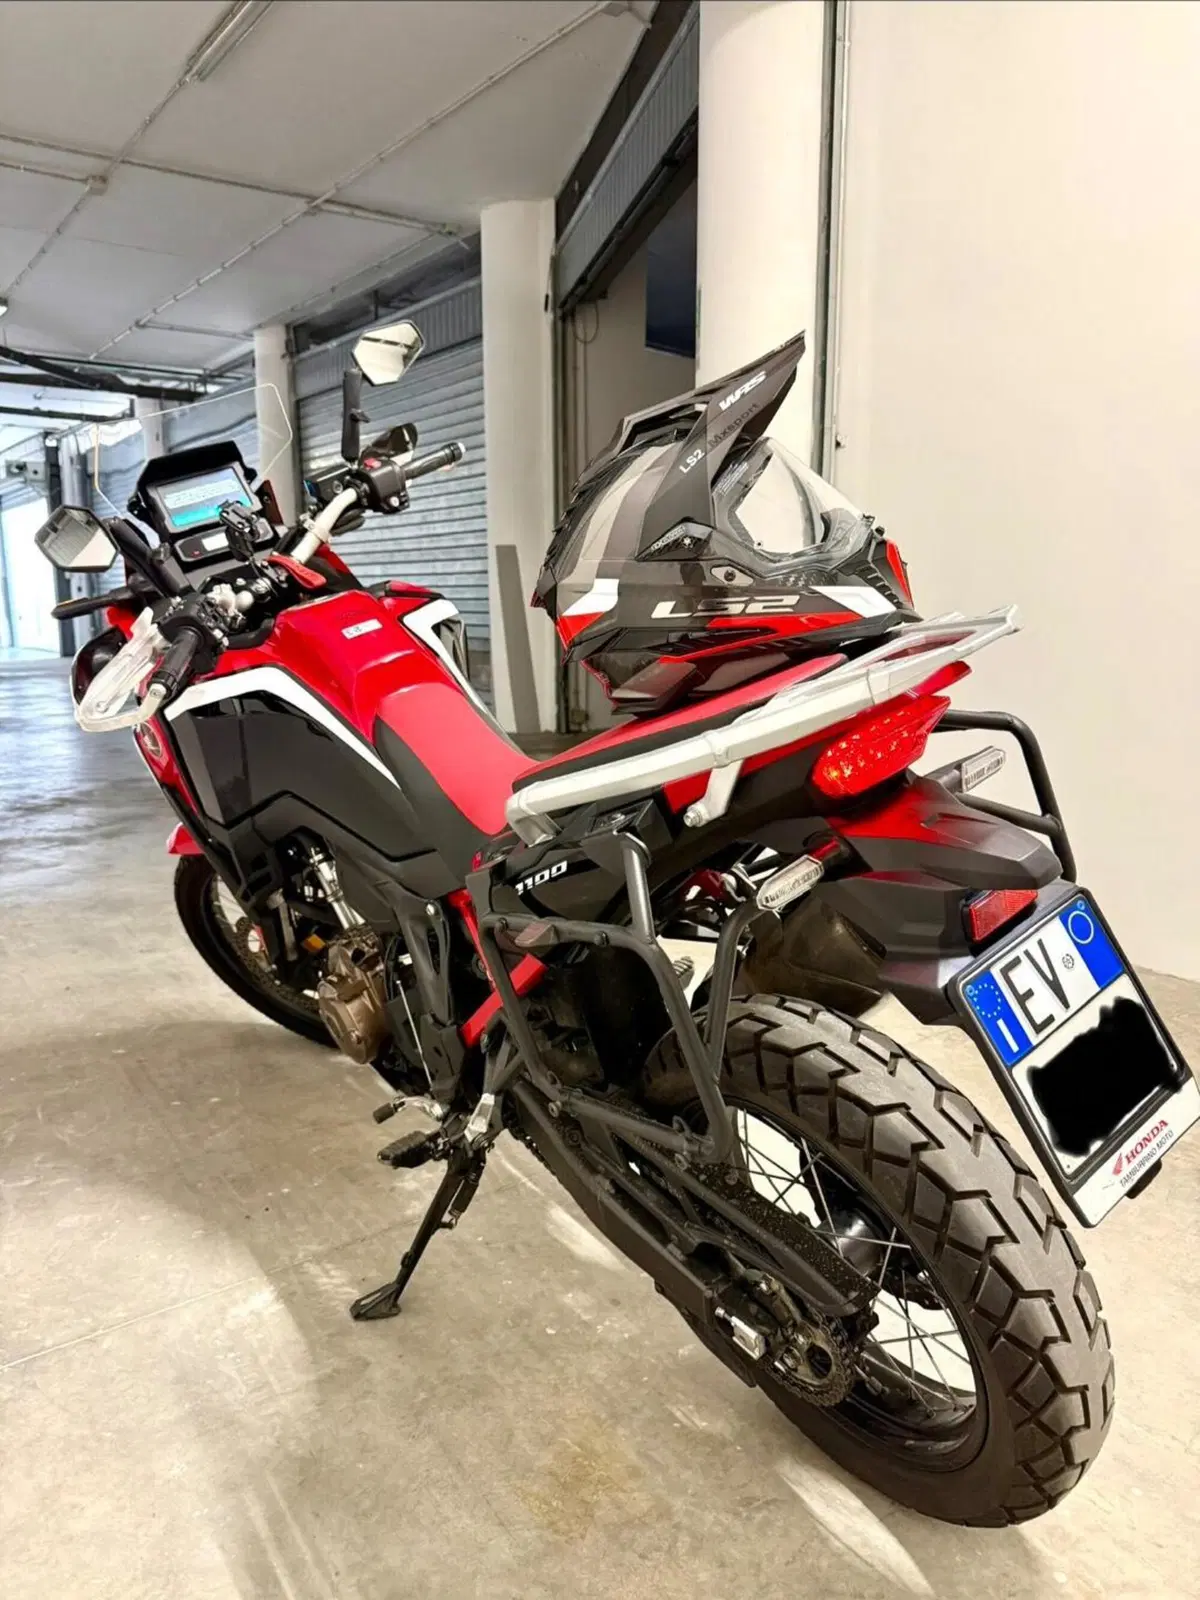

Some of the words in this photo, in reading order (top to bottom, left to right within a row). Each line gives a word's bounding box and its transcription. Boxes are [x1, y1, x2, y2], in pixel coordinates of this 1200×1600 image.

[679, 449, 705, 473] LS2
[651, 595, 800, 619] LS2
[515, 860, 567, 895] 1100
[1000, 938, 1071, 1035] EV
[1125, 1119, 1168, 1165] HONDA
[1156, 1130, 1174, 1151] MOTO
